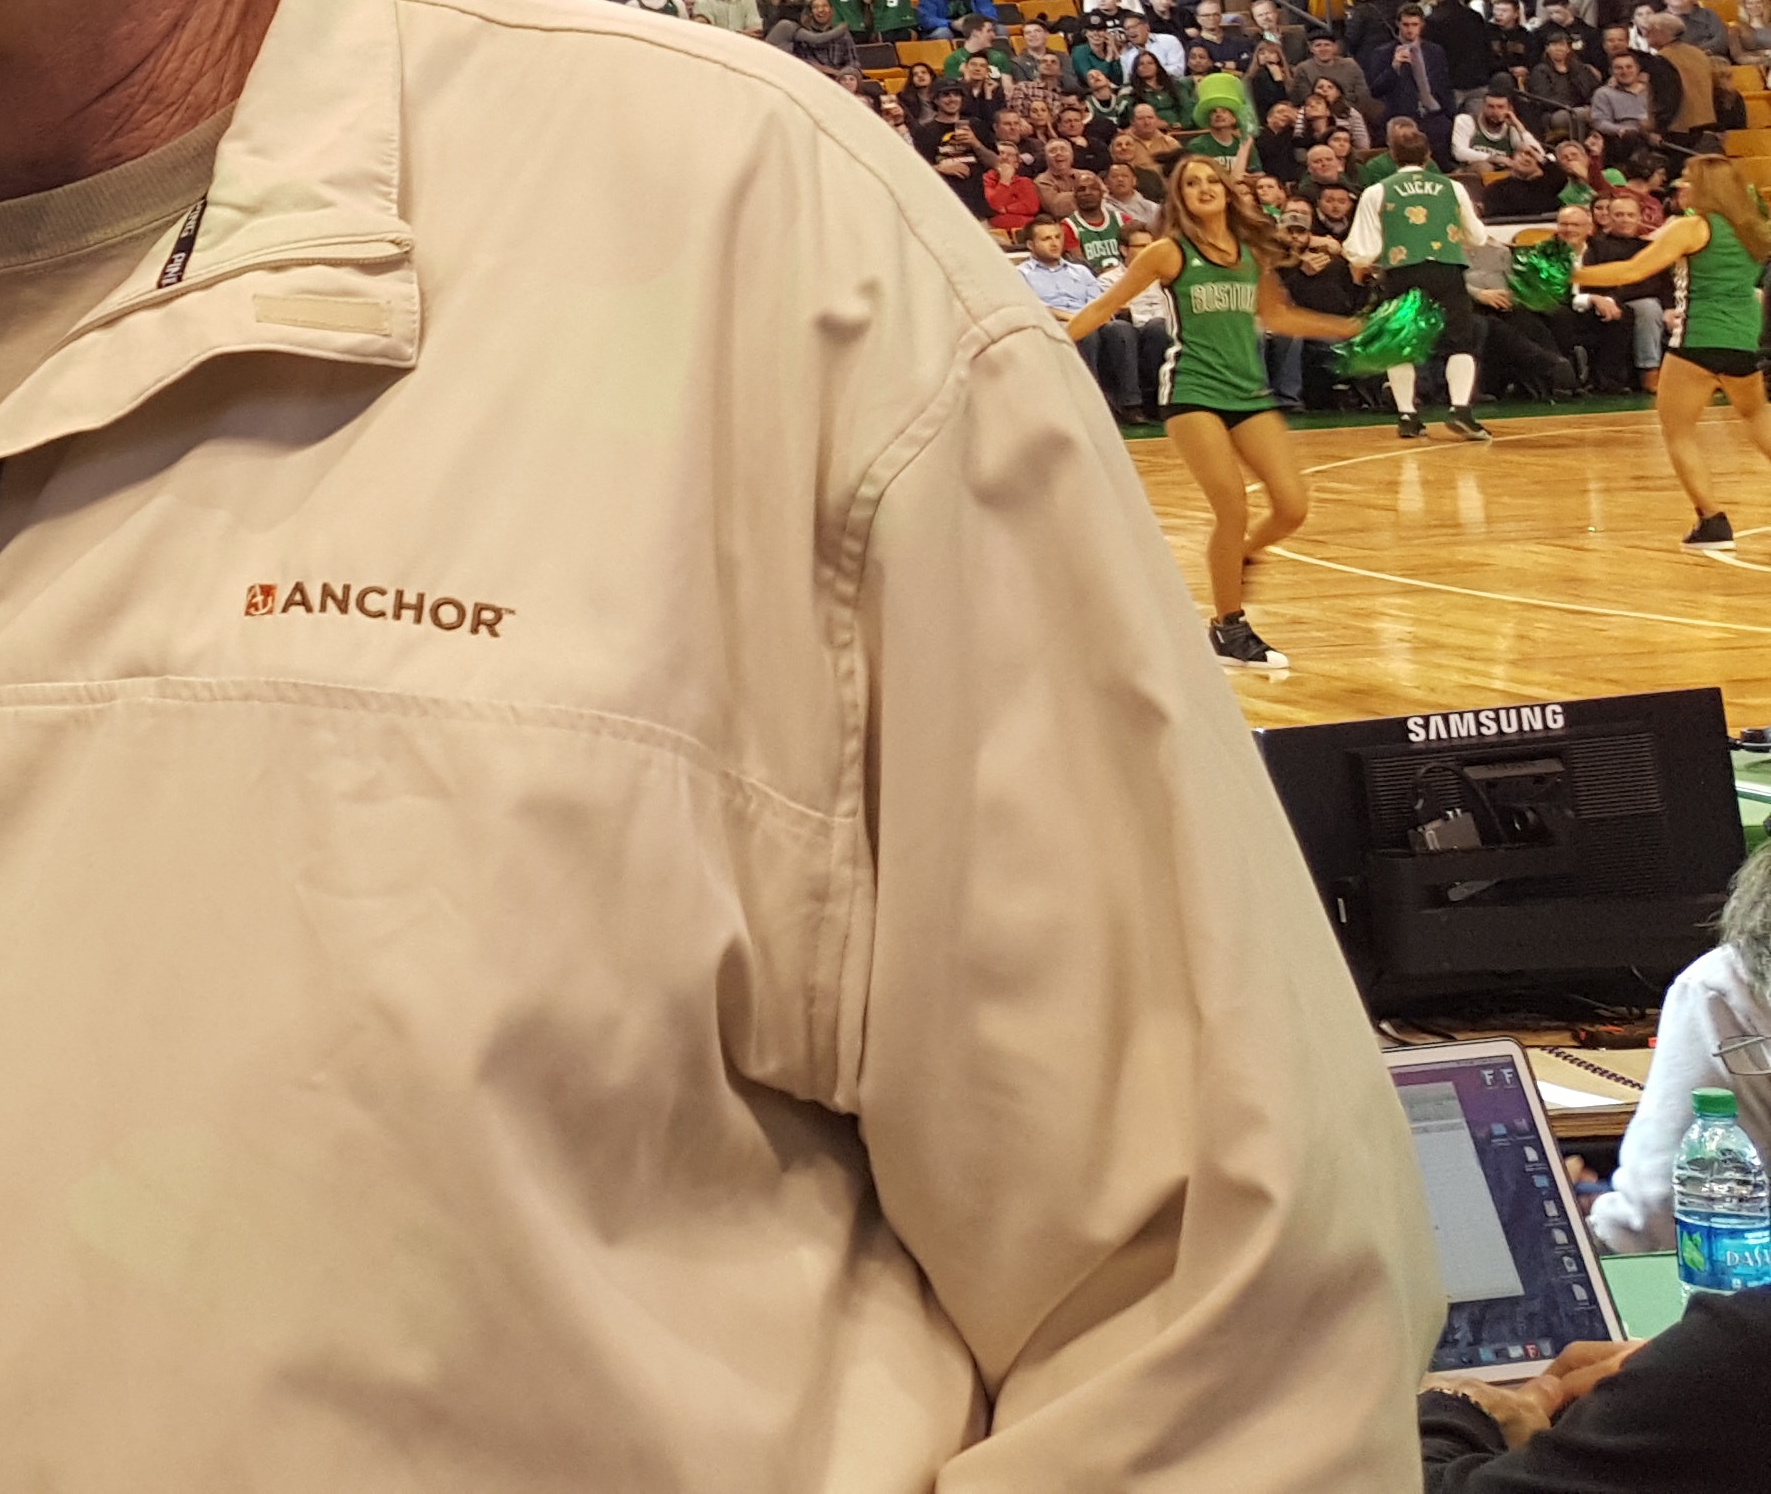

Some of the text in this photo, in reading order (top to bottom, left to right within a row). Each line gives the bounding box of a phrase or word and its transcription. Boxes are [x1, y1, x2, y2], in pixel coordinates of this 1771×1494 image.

[1394, 181, 1444, 197] LUCKY
[279, 581, 504, 638] ANCHOR
[1406, 704, 1565, 743] SAMSUNG
